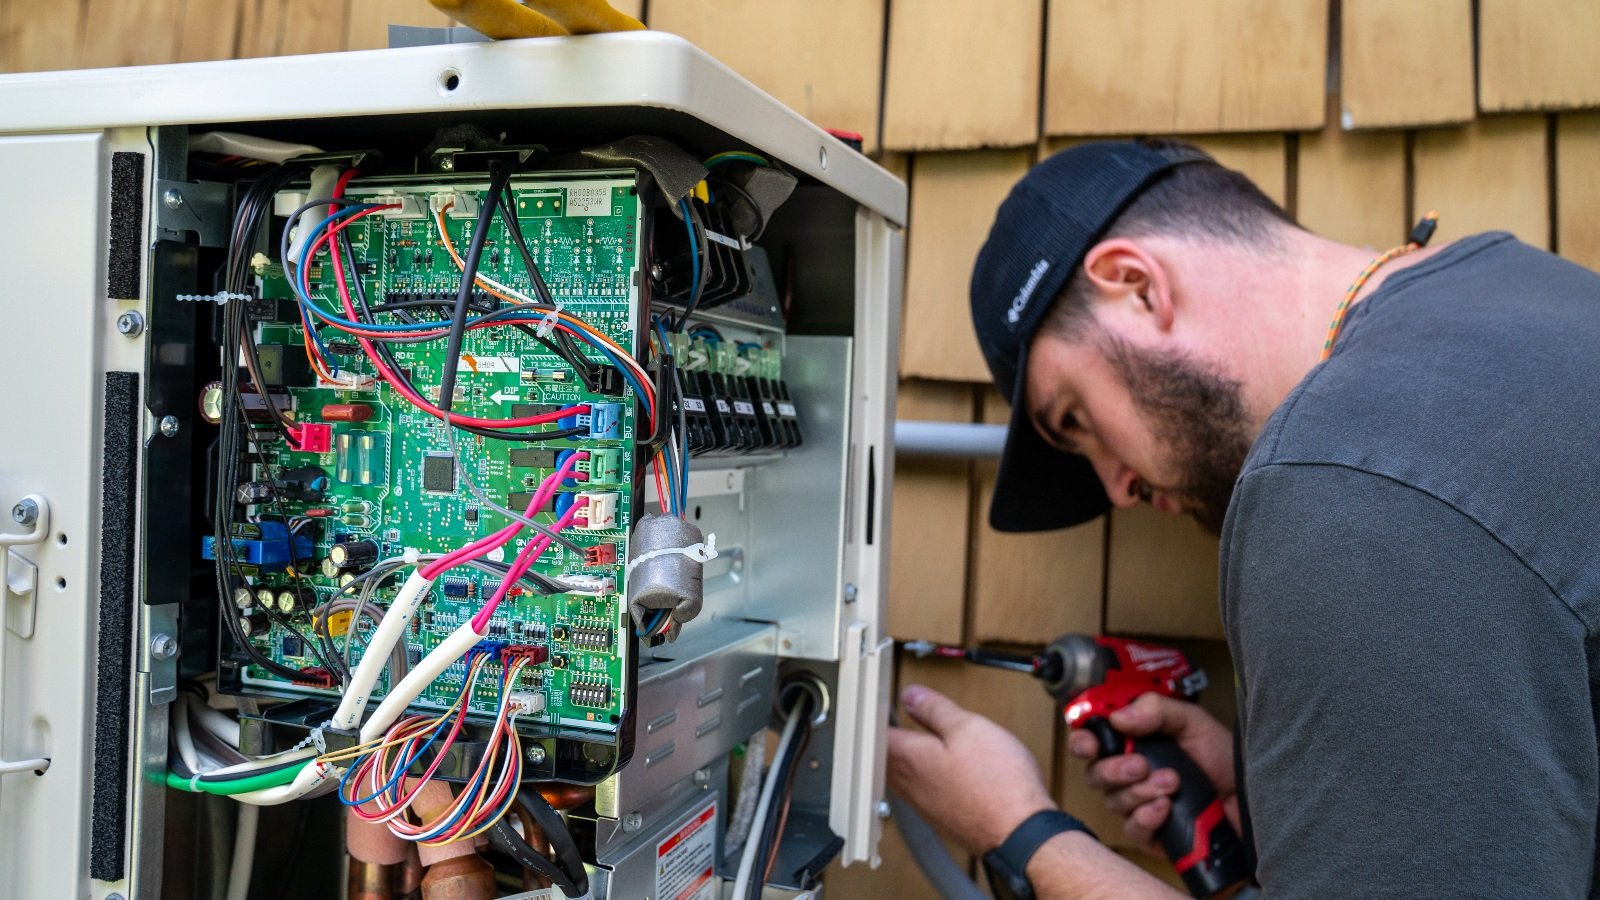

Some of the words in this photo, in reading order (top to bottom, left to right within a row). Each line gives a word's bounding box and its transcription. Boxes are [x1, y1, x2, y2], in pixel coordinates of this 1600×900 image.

[1012, 259, 1050, 312] Columbia
[395, 351, 405, 360] RD
[504, 386, 518, 394] DIP
[626, 384, 634, 396] BK
[334, 391, 344, 399] WH
[545, 393, 581, 401] CAUTION
[625, 425, 632, 439] BU
[624, 470, 631, 483] GN
[622, 511, 630, 525] WH
[516, 538, 527, 546] GN
[617, 552, 625, 566] RD
[544, 669, 555, 677] RD
[436, 698, 447, 706] GN
[476, 702, 486, 711] YE
